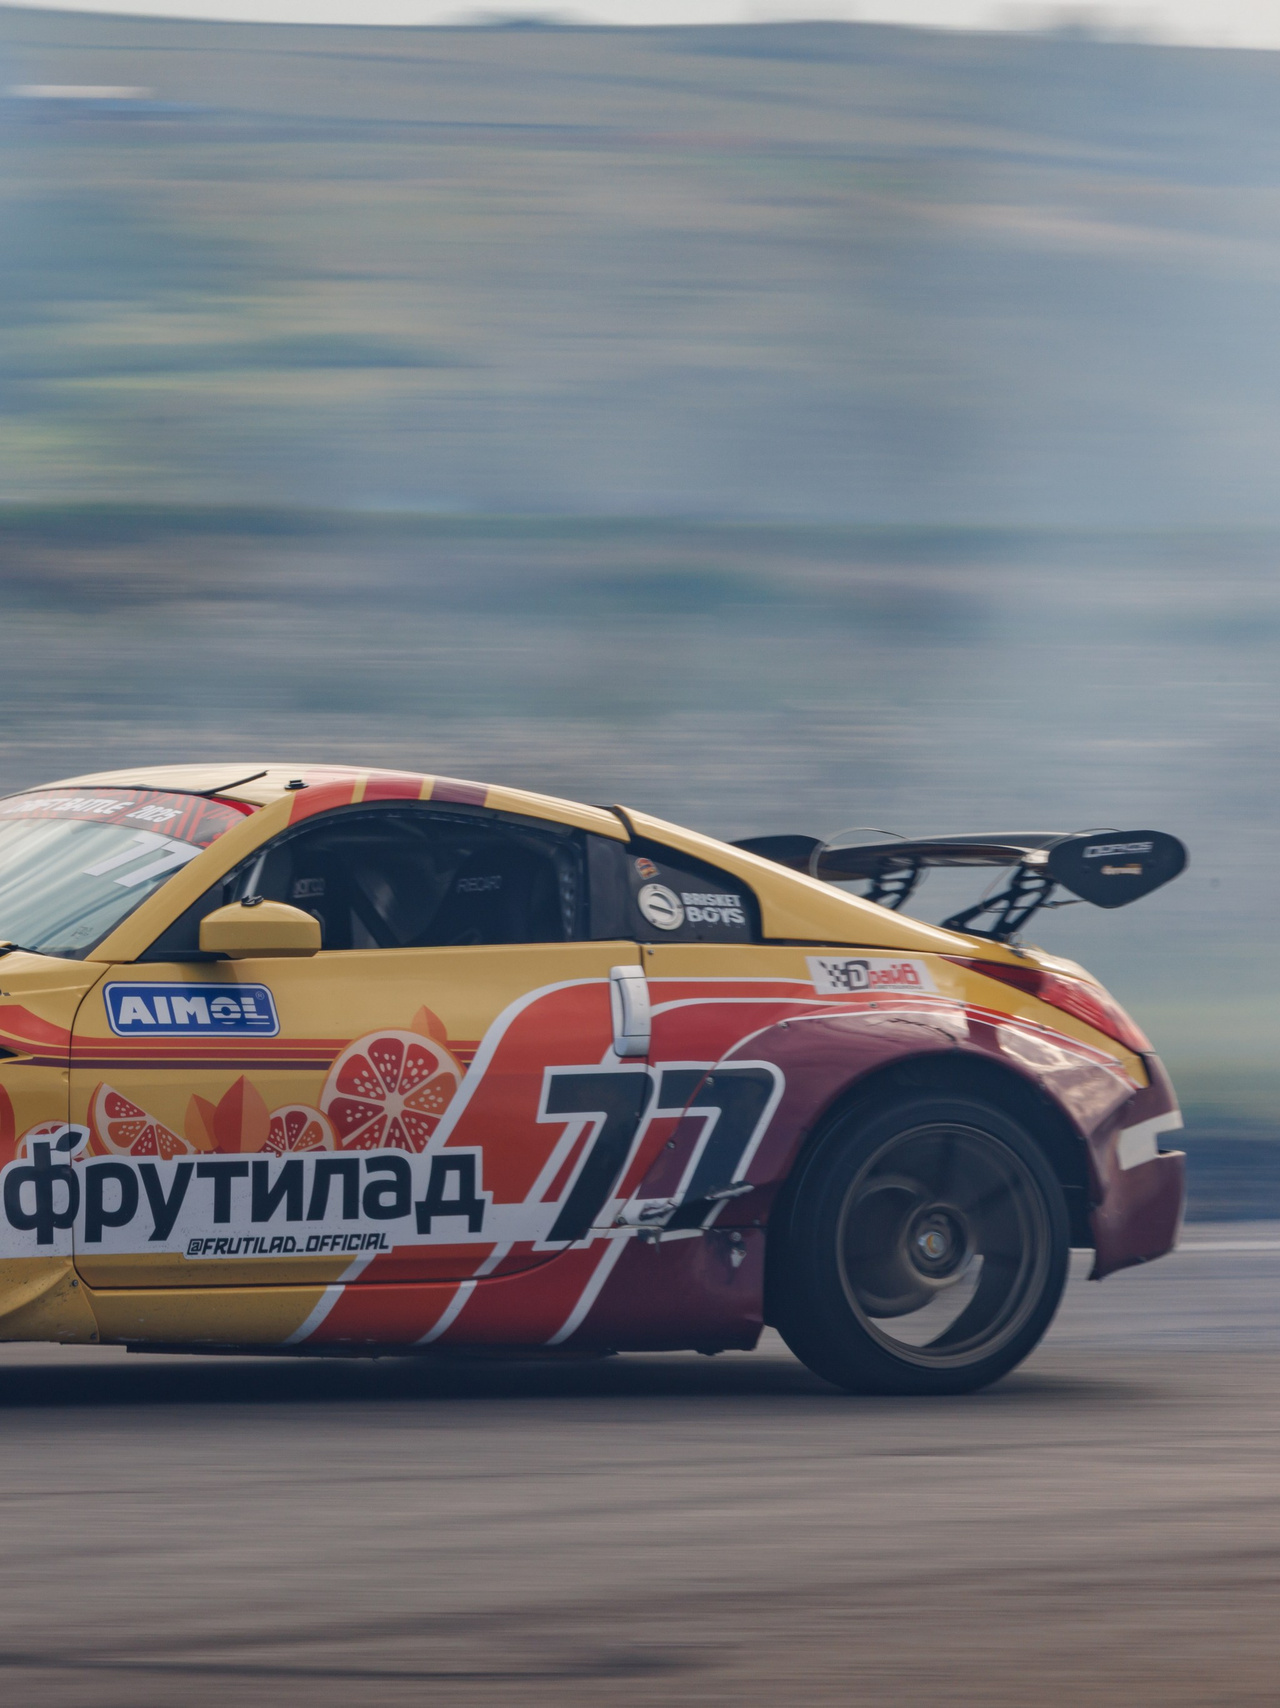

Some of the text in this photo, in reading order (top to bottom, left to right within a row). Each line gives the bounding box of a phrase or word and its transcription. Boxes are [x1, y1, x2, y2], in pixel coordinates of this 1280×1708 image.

[126, 804, 184, 823] 2025
[680, 892, 741, 907] BRISKET
[686, 906, 746, 924] BOYS
[118, 995, 271, 1025] AIMOL
[536, 1062, 784, 1247] 77
[186, 1232, 390, 1255] @FRUTILAD_OFFICIAL
